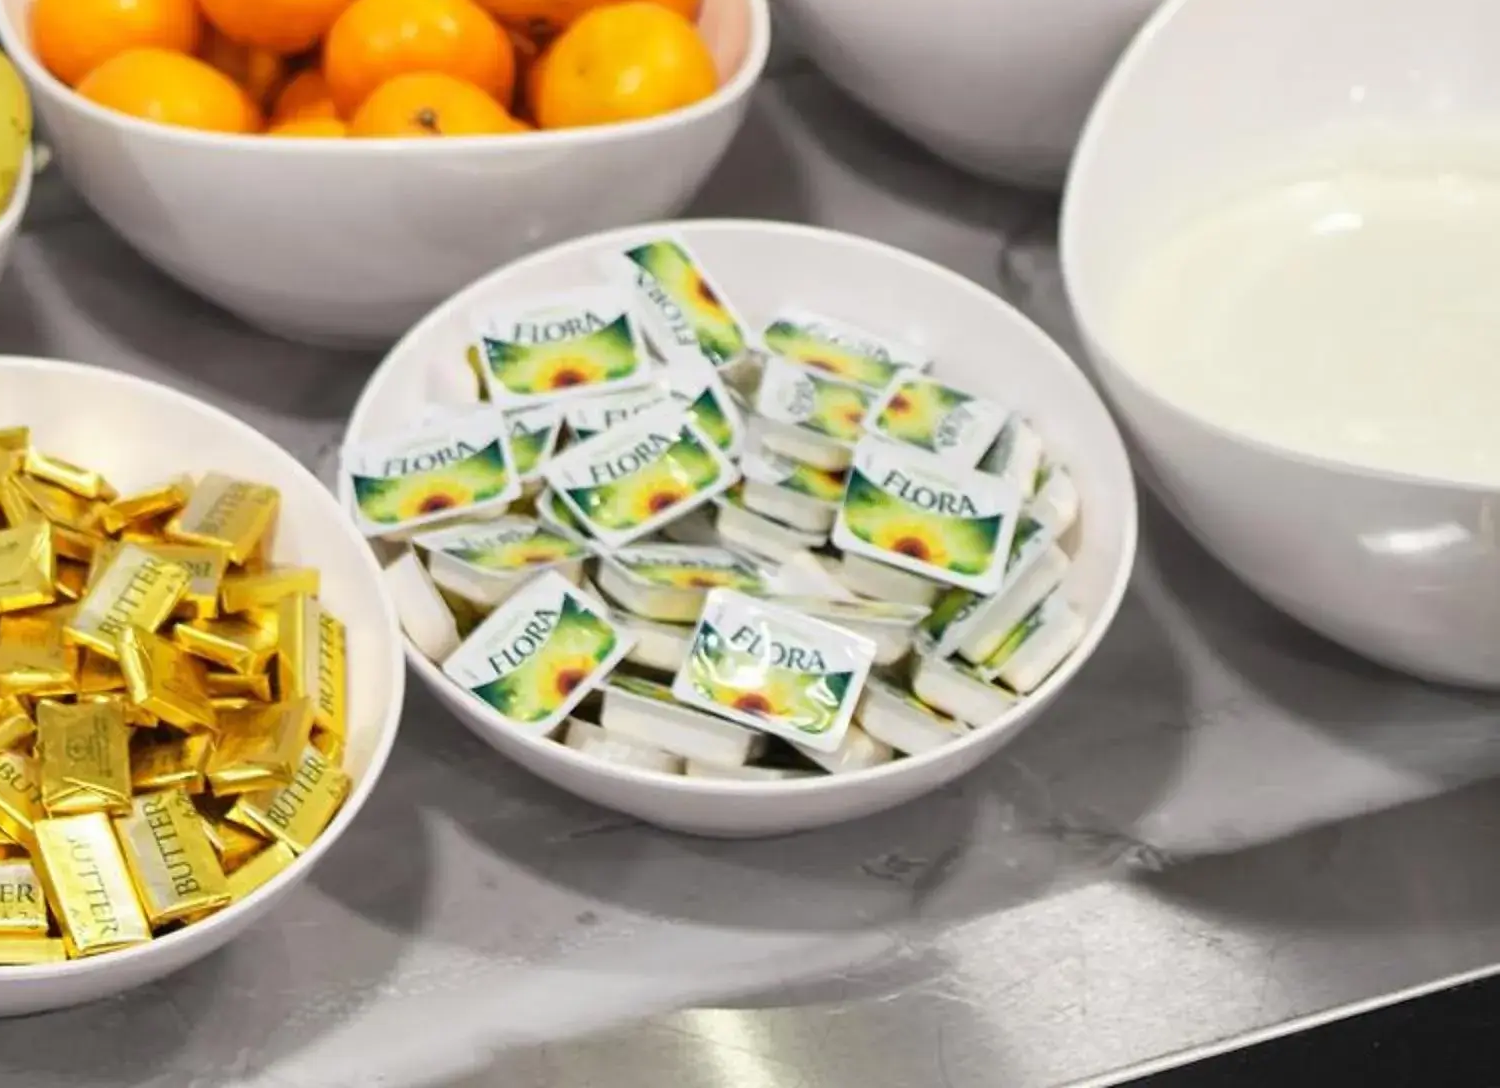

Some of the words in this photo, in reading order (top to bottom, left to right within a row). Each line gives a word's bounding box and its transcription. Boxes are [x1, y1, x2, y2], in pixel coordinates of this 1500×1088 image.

[513, 311, 605, 345] FLORA
[383, 440, 478, 476] FLORA
[588, 432, 672, 485] FLORA
[882, 469, 978, 515] FLORA
[98, 557, 162, 636] BUTTER
[487, 607, 557, 677] FLORA
[729, 624, 826, 670] FLORA
[266, 756, 327, 829] BUTTER
[143, 794, 200, 898] BUTTER
